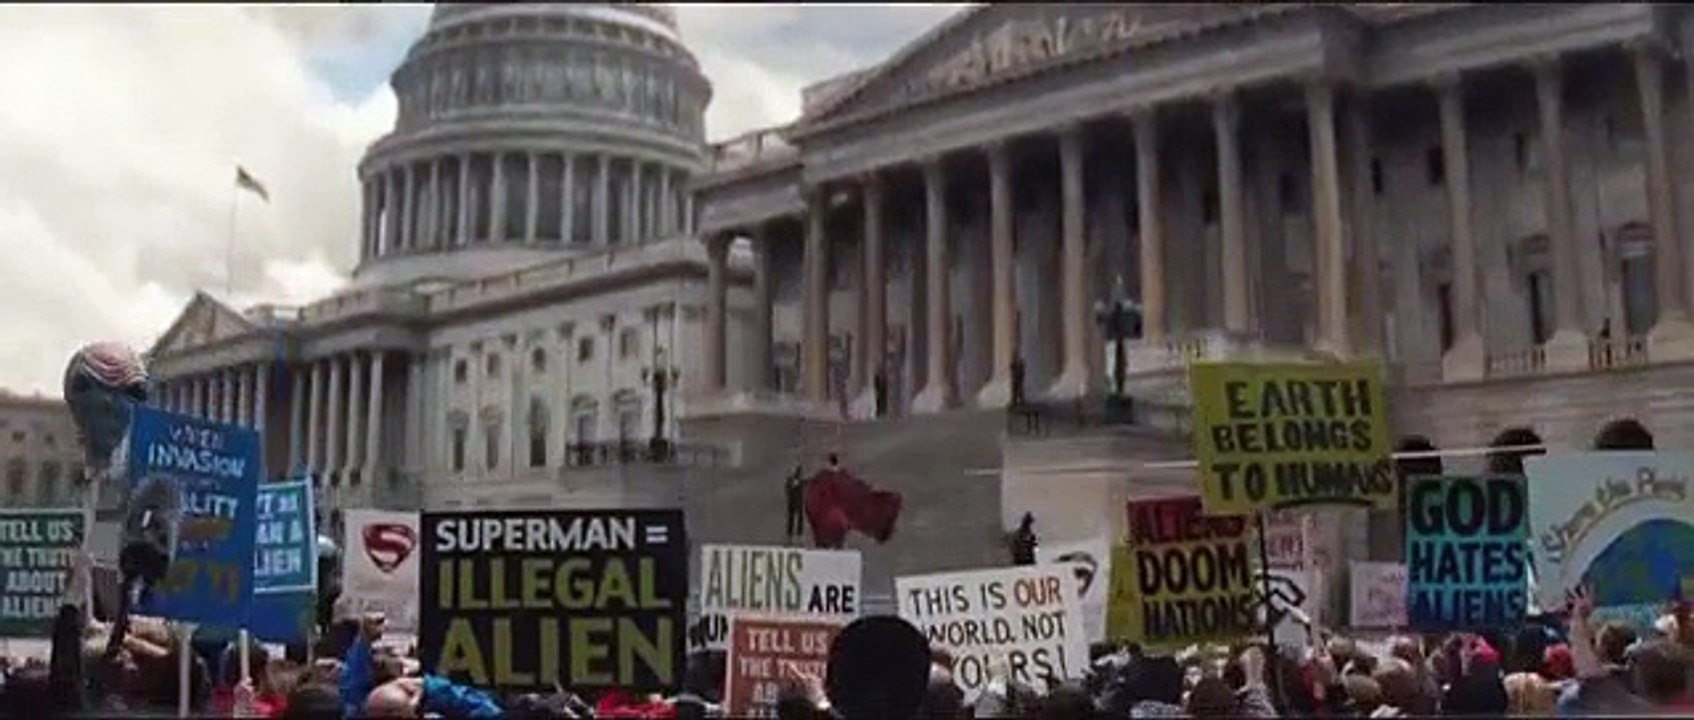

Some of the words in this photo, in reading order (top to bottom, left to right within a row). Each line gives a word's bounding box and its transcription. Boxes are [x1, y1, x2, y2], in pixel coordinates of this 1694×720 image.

[1225, 379, 1373, 420] EARTH
[1211, 419, 1373, 453] BELONGS
[147, 441, 245, 478] INVASION
[1212, 462, 1268, 502] TO
[1275, 459, 1394, 496] HUMANS
[1409, 479, 1525, 538] GOD
[47, 520, 74, 542] US
[436, 517, 636, 552] SUPERMAN
[438, 556, 671, 610] ILLEGAL
[706, 549, 804, 611] ALIENS
[808, 584, 855, 614] ARE
[1136, 541, 1250, 597] DOOM
[1410, 541, 1526, 585] HATES
[909, 584, 970, 617] THIS
[980, 582, 1008, 611] IS
[1014, 576, 1064, 608] OUR
[1143, 594, 1254, 637] NATIONS
[1412, 588, 1525, 629] ALIENS
[747, 628, 796, 653] TELL
[801, 630, 830, 656] US
[1021, 610, 1066, 641] NOT
[438, 616, 674, 685] ALIEN
[738, 655, 773, 678] THE
